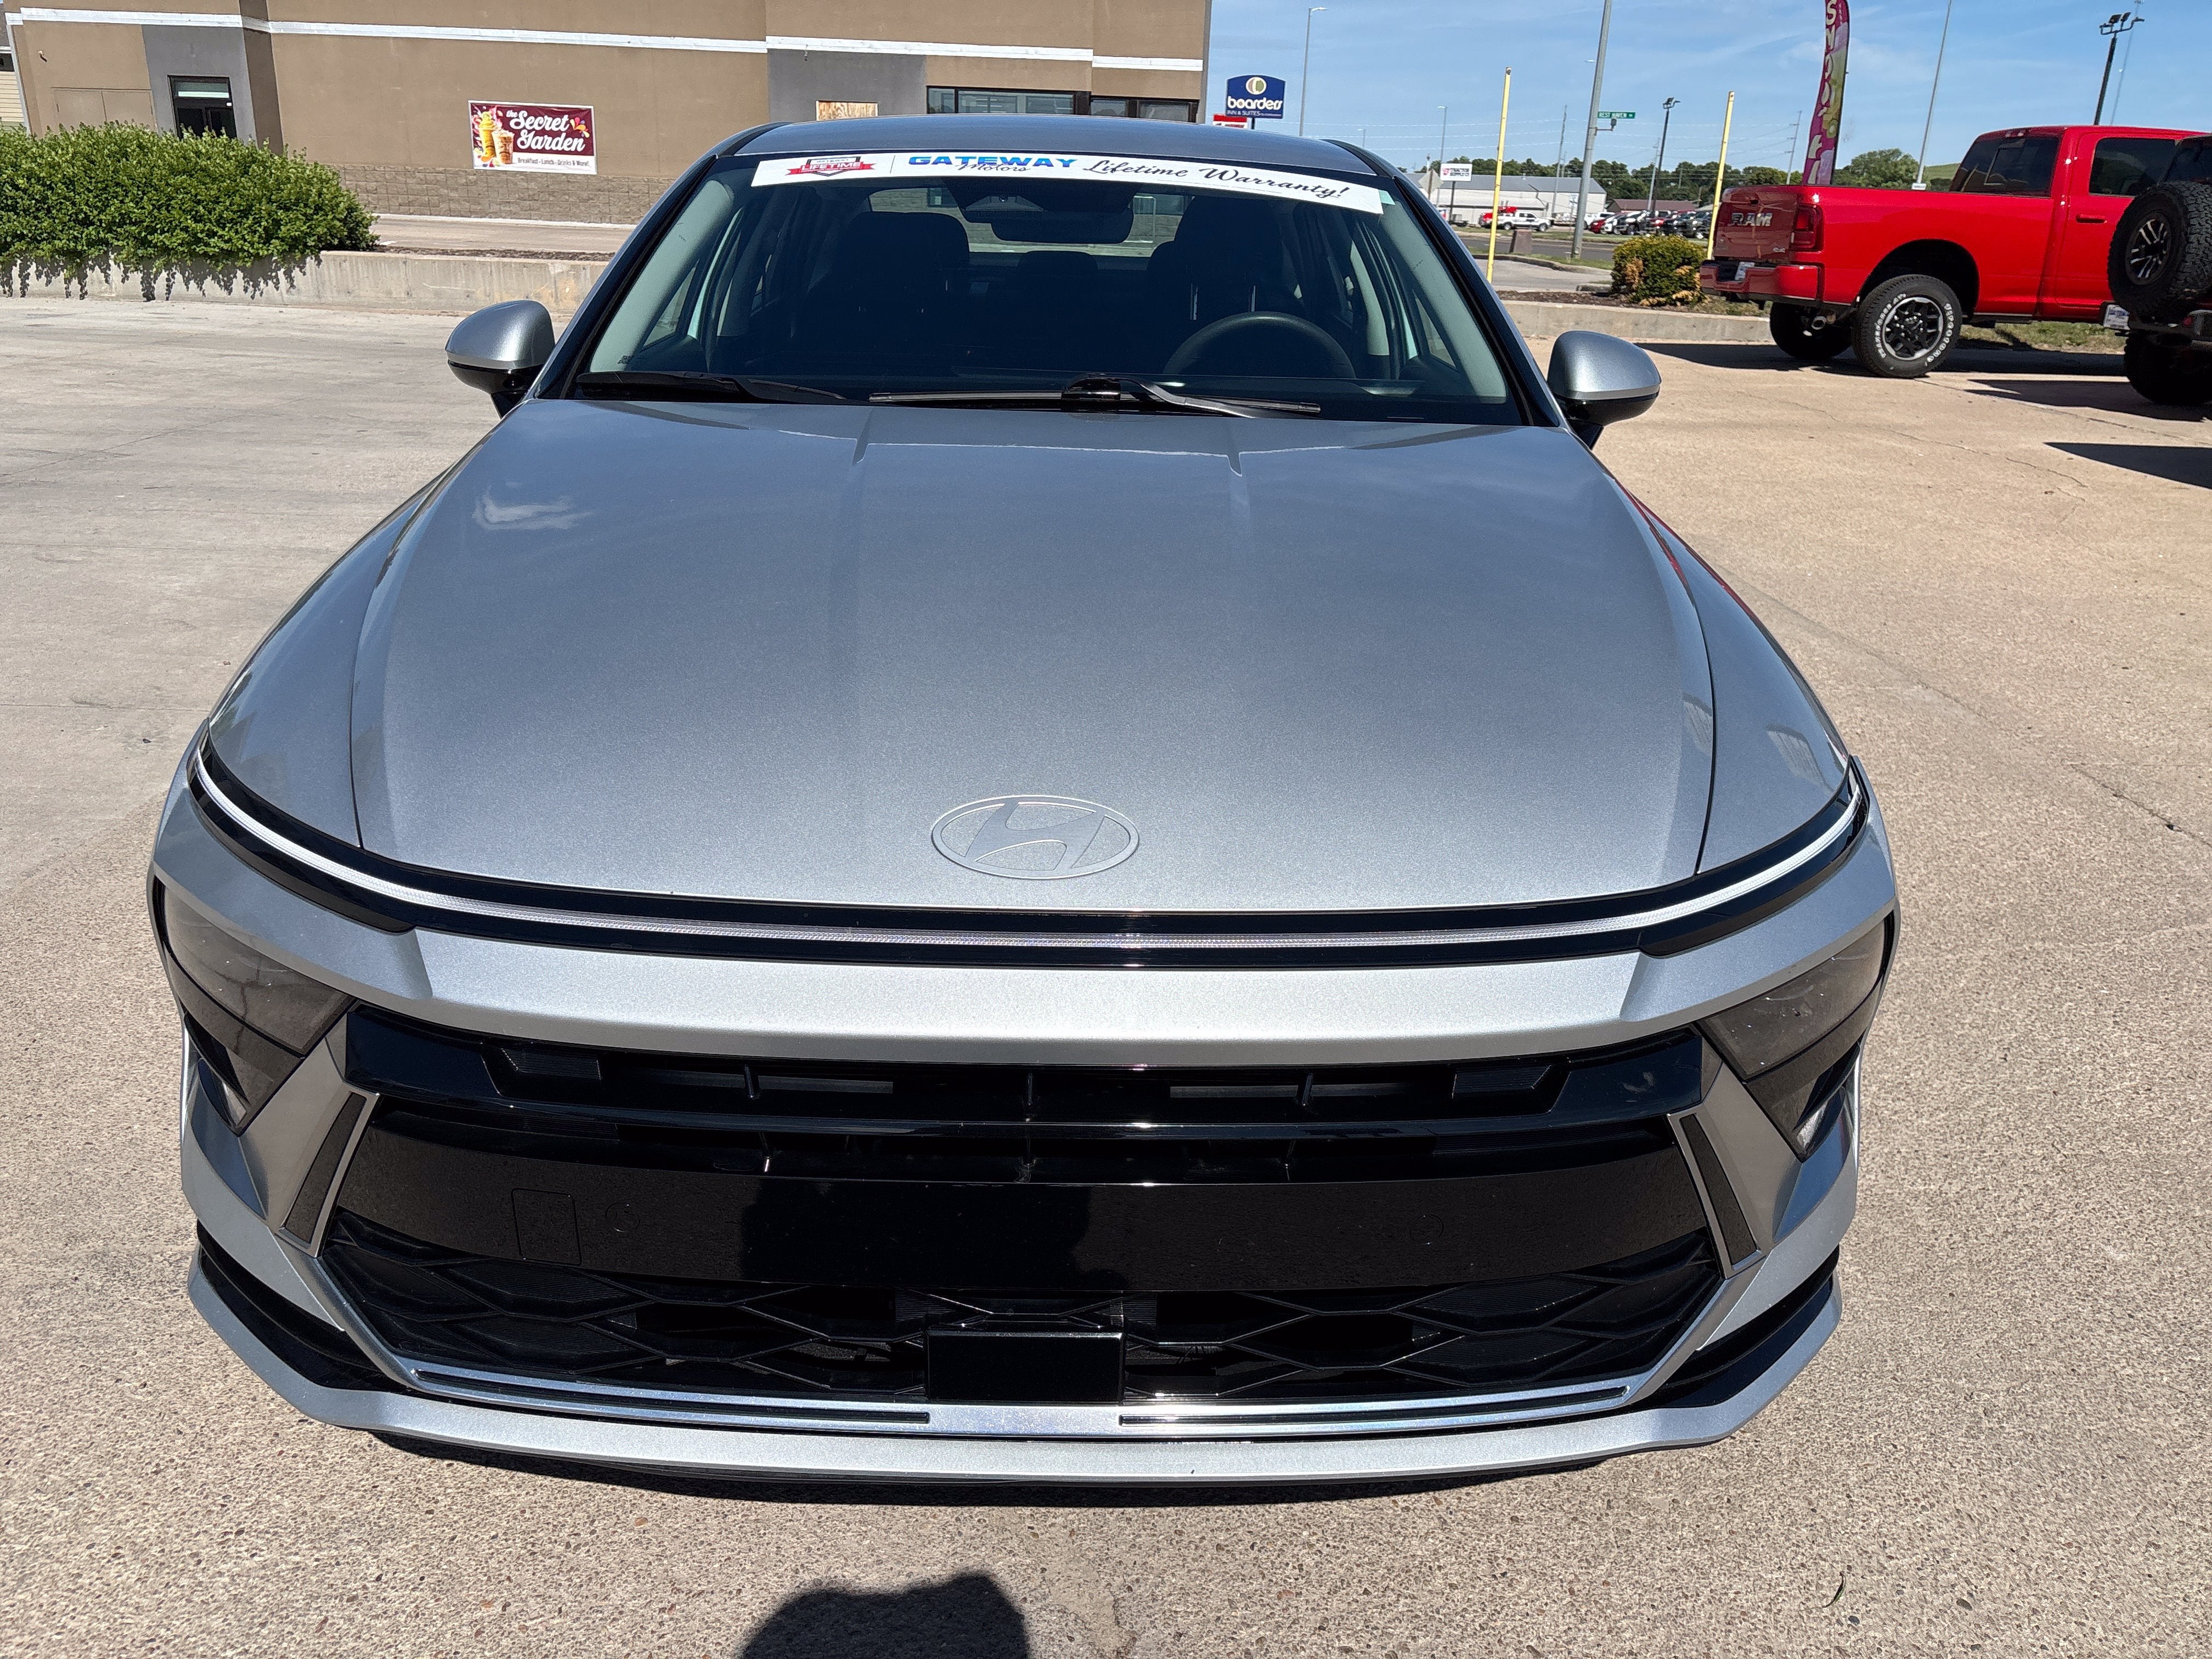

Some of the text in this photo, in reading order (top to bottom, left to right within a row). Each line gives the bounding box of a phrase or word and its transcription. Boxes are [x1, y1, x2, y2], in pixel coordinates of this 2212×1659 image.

[509, 110, 570, 132] Secret
[517, 129, 586, 152] Garden
[801, 162, 861, 171] LIFETIME
[908, 156, 1077, 168] GATEWAY
[955, 162, 1031, 172] Motors
[1083, 160, 1189, 178] Lifetime
[1198, 167, 1351, 200] Warranty!
[1731, 212, 1773, 227] RAM
